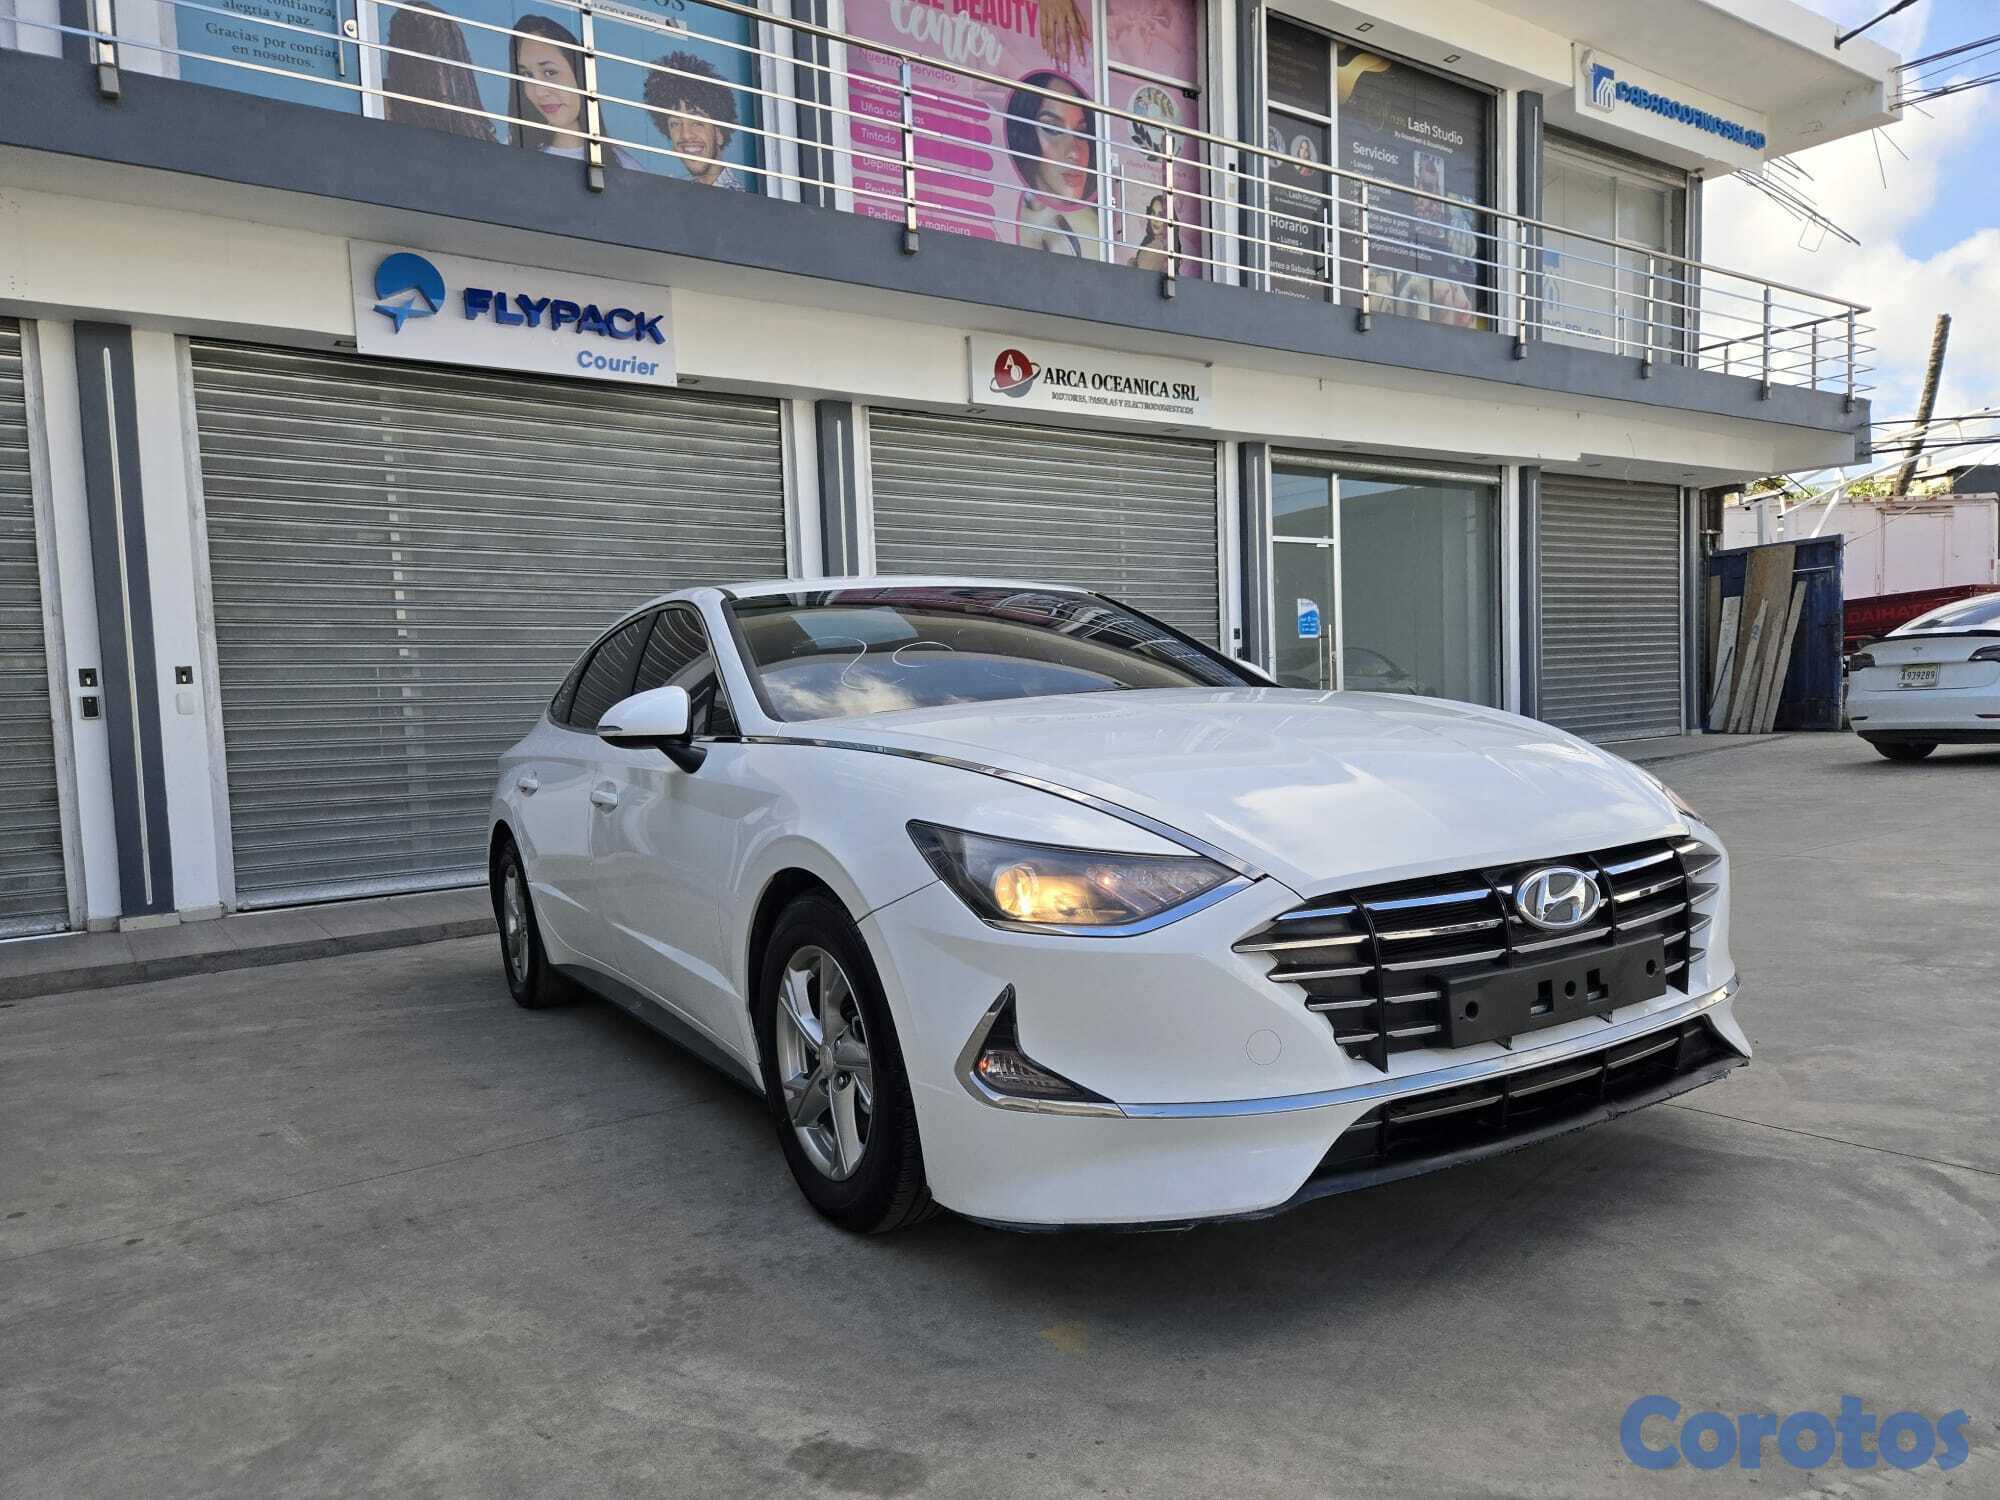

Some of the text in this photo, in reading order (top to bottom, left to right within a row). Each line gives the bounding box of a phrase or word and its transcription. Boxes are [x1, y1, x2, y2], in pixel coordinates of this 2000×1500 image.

[205, 22, 340, 61] Gracias por confiar
[231, 44, 315, 69] en nosotros.
[857, 47, 904, 68] Nuestro
[860, 127, 897, 145] Tintado
[1407, 116, 1431, 135] Lash
[1431, 124, 1464, 145] Studio
[867, 206, 906, 223] Pedicu
[924, 219, 971, 235] manicura
[1270, 215, 1309, 234] Horario
[463, 287, 666, 345] FLYPACK
[576, 350, 659, 376] Courier
[1043, 367, 1200, 401] ARCA OCEANICA SRL
[1089, 394, 1118, 407] PASOLAS
[1118, 399, 1124, 408] Y
[1848, 600, 1936, 622] DAIHAT
